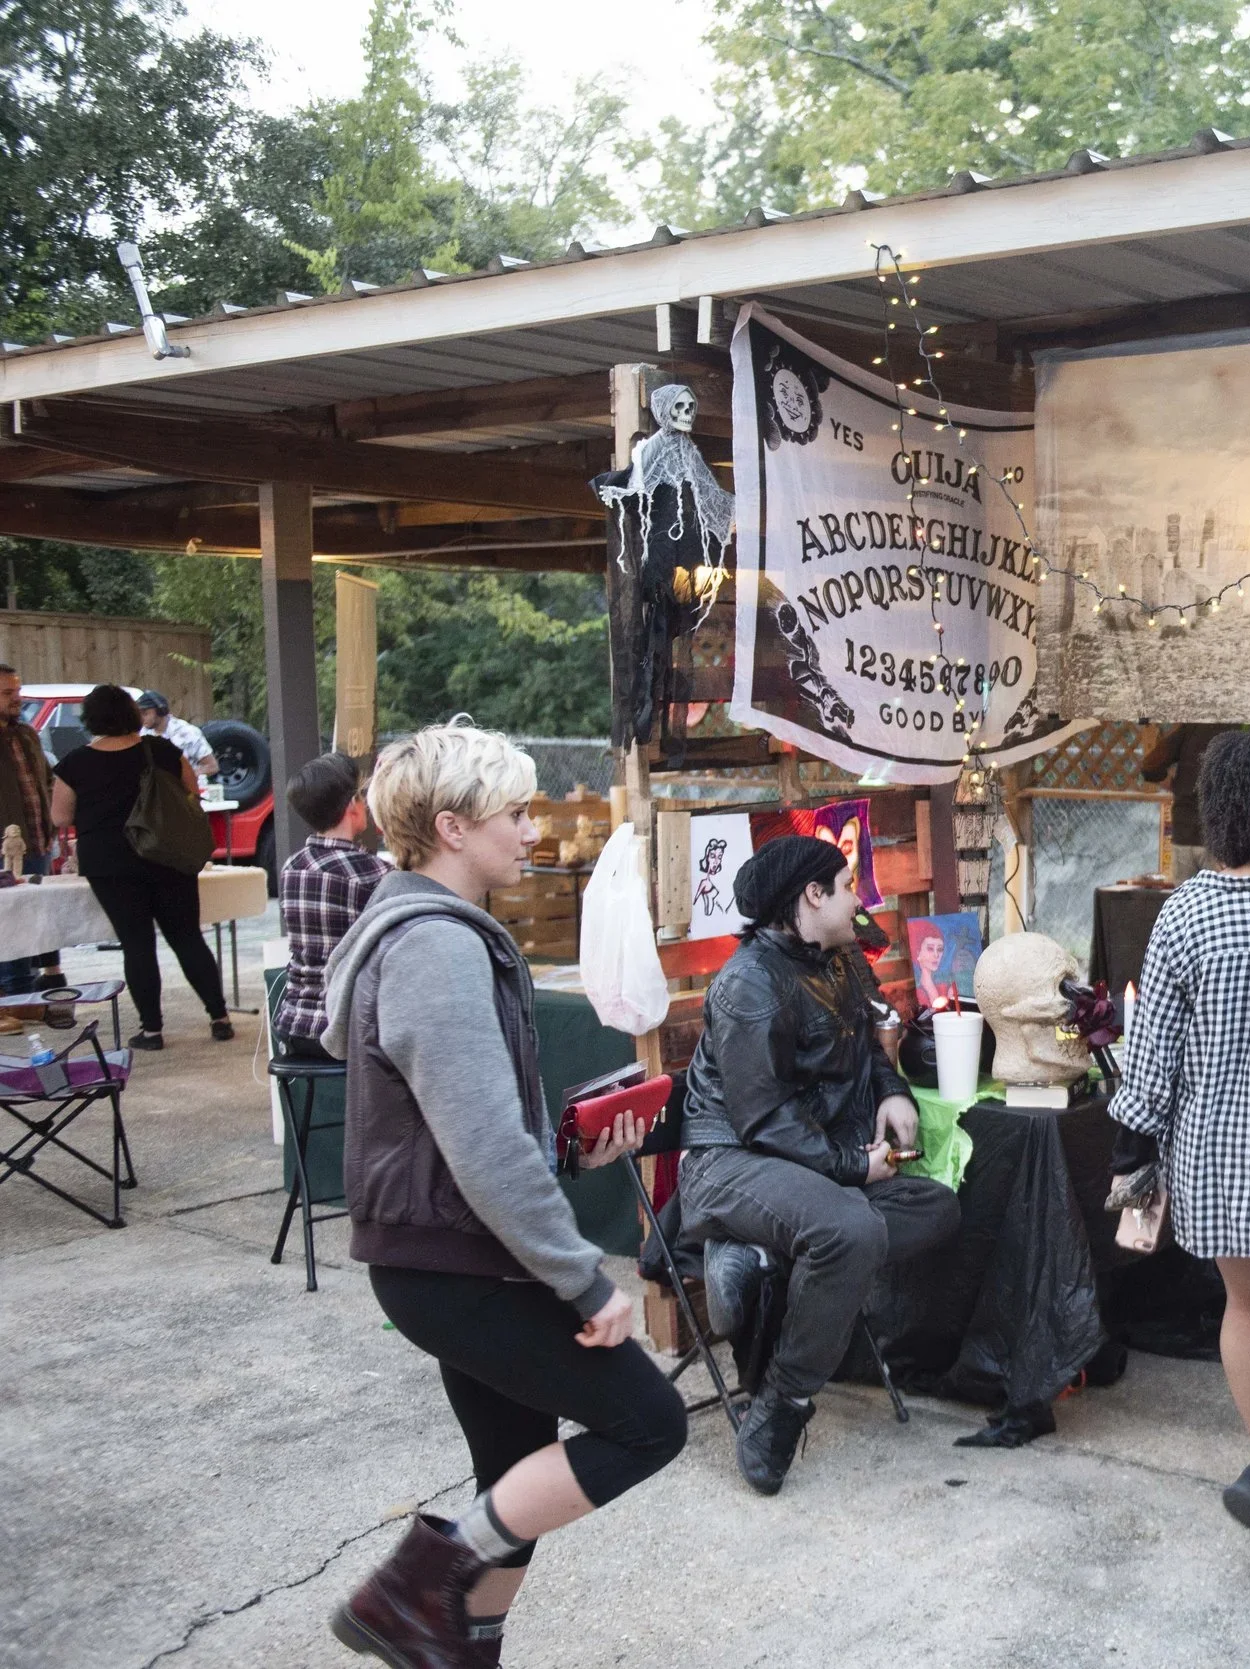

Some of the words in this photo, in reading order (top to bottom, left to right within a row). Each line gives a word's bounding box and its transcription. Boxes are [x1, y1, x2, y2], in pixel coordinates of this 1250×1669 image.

[829, 417, 864, 452] YES
[890, 450, 982, 505] OUIJA
[1003, 466, 1024, 485] NO
[797, 510, 1036, 584] ABCDEFGHIJKL
[797, 564, 1036, 646] NOPQRSTUVWXY
[845, 637, 1023, 697] 1234567890
